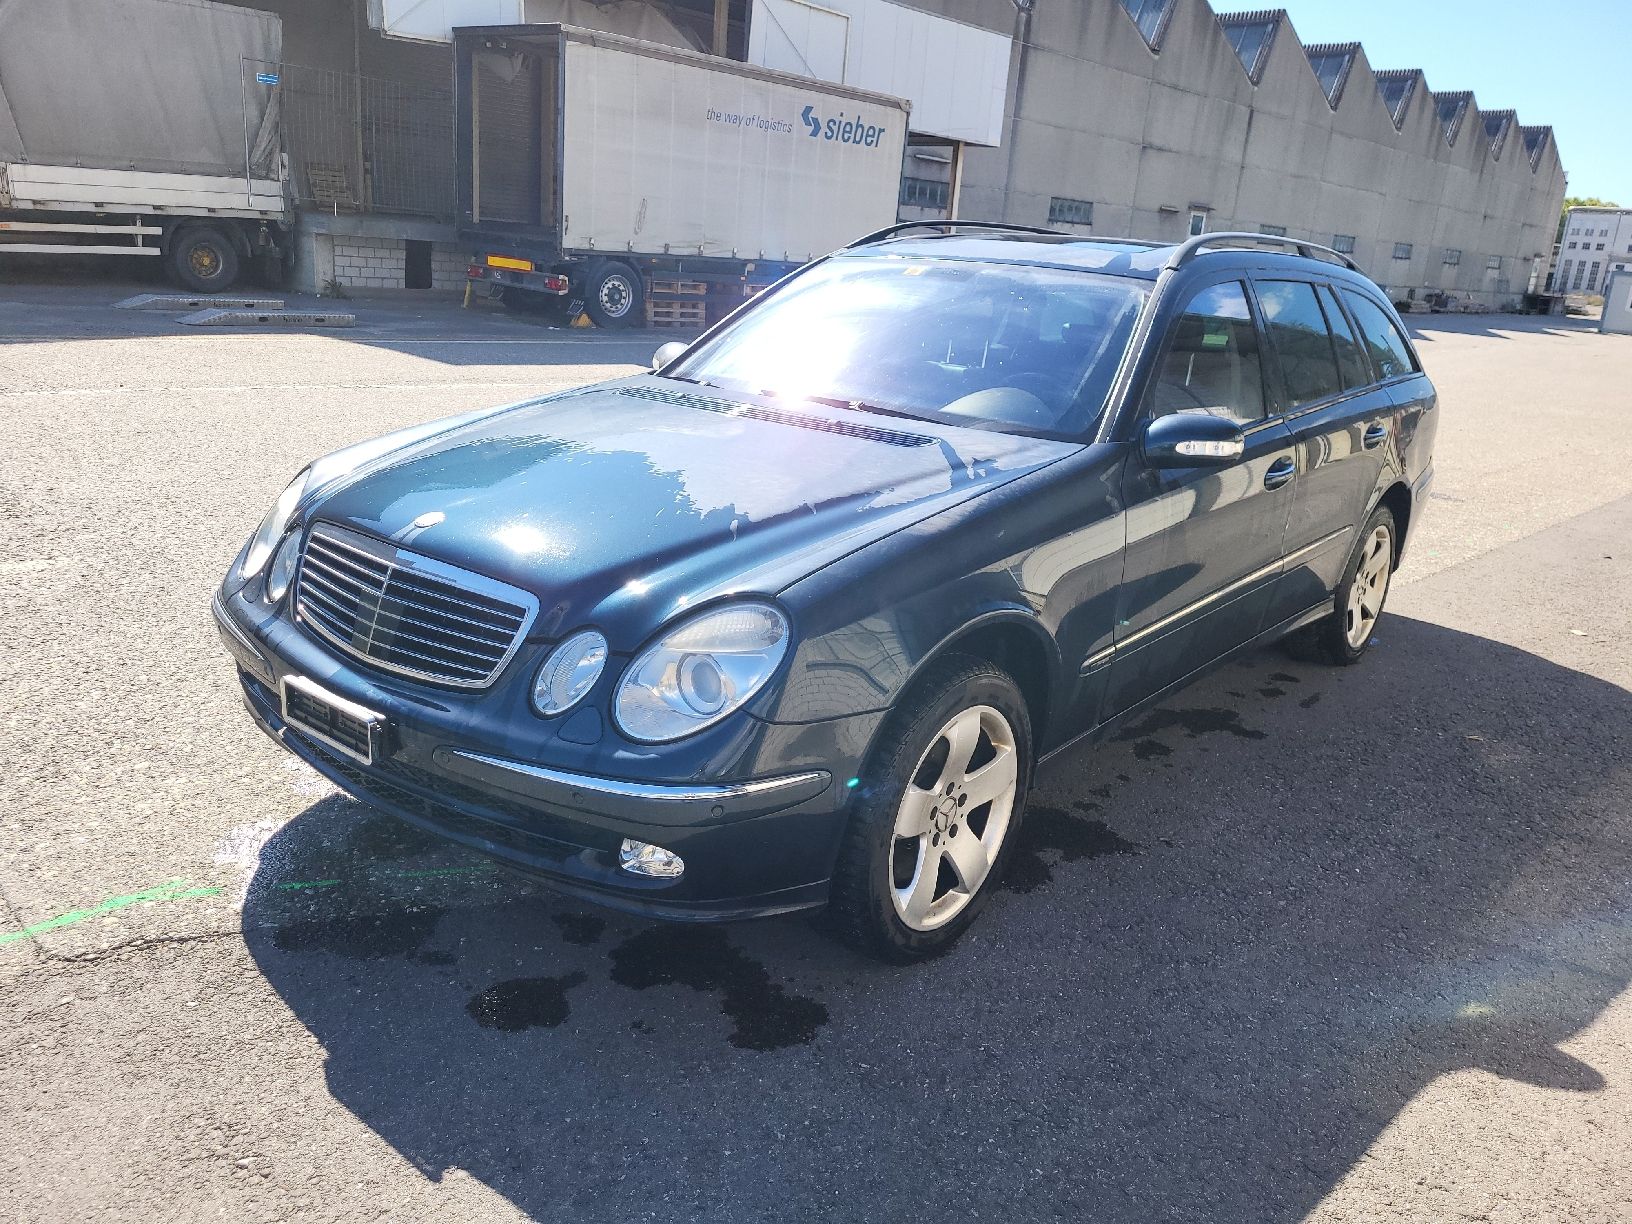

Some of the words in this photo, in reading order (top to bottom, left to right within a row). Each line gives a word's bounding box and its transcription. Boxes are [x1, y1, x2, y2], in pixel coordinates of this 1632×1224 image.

[706, 107, 722, 122] the
[724, 113, 744, 128] way
[745, 114, 758, 127] of
[756, 114, 793, 134] logistics
[824, 111, 886, 148] sieber
